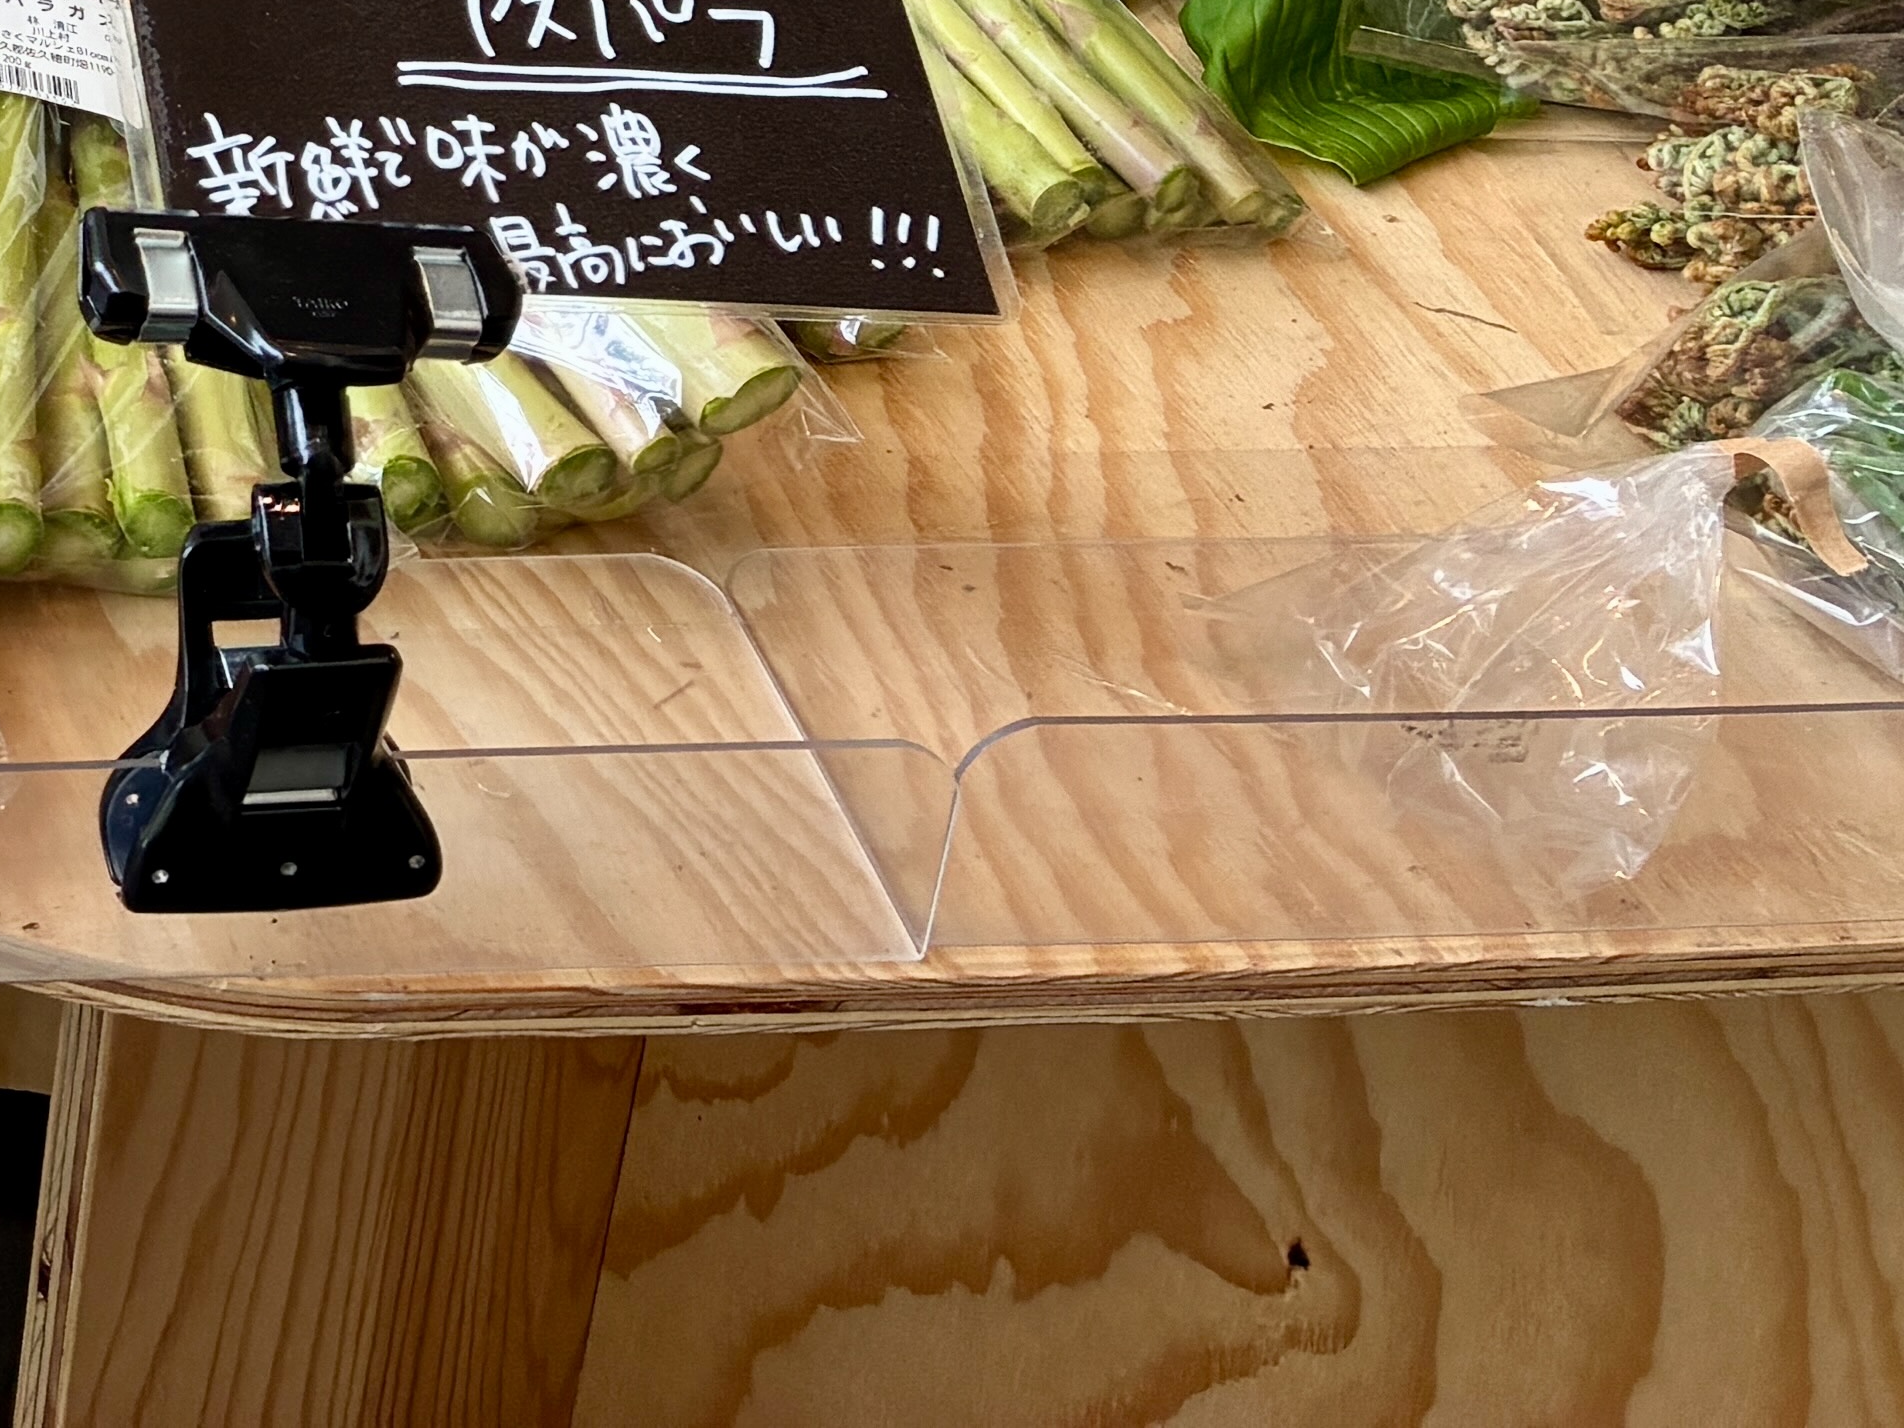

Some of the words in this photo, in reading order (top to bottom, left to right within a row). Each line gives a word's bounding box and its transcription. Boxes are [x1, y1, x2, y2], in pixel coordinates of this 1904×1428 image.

[32, 27, 70, 43] 川上村
[186, 101, 711, 218] 新鮮で味が濃く
